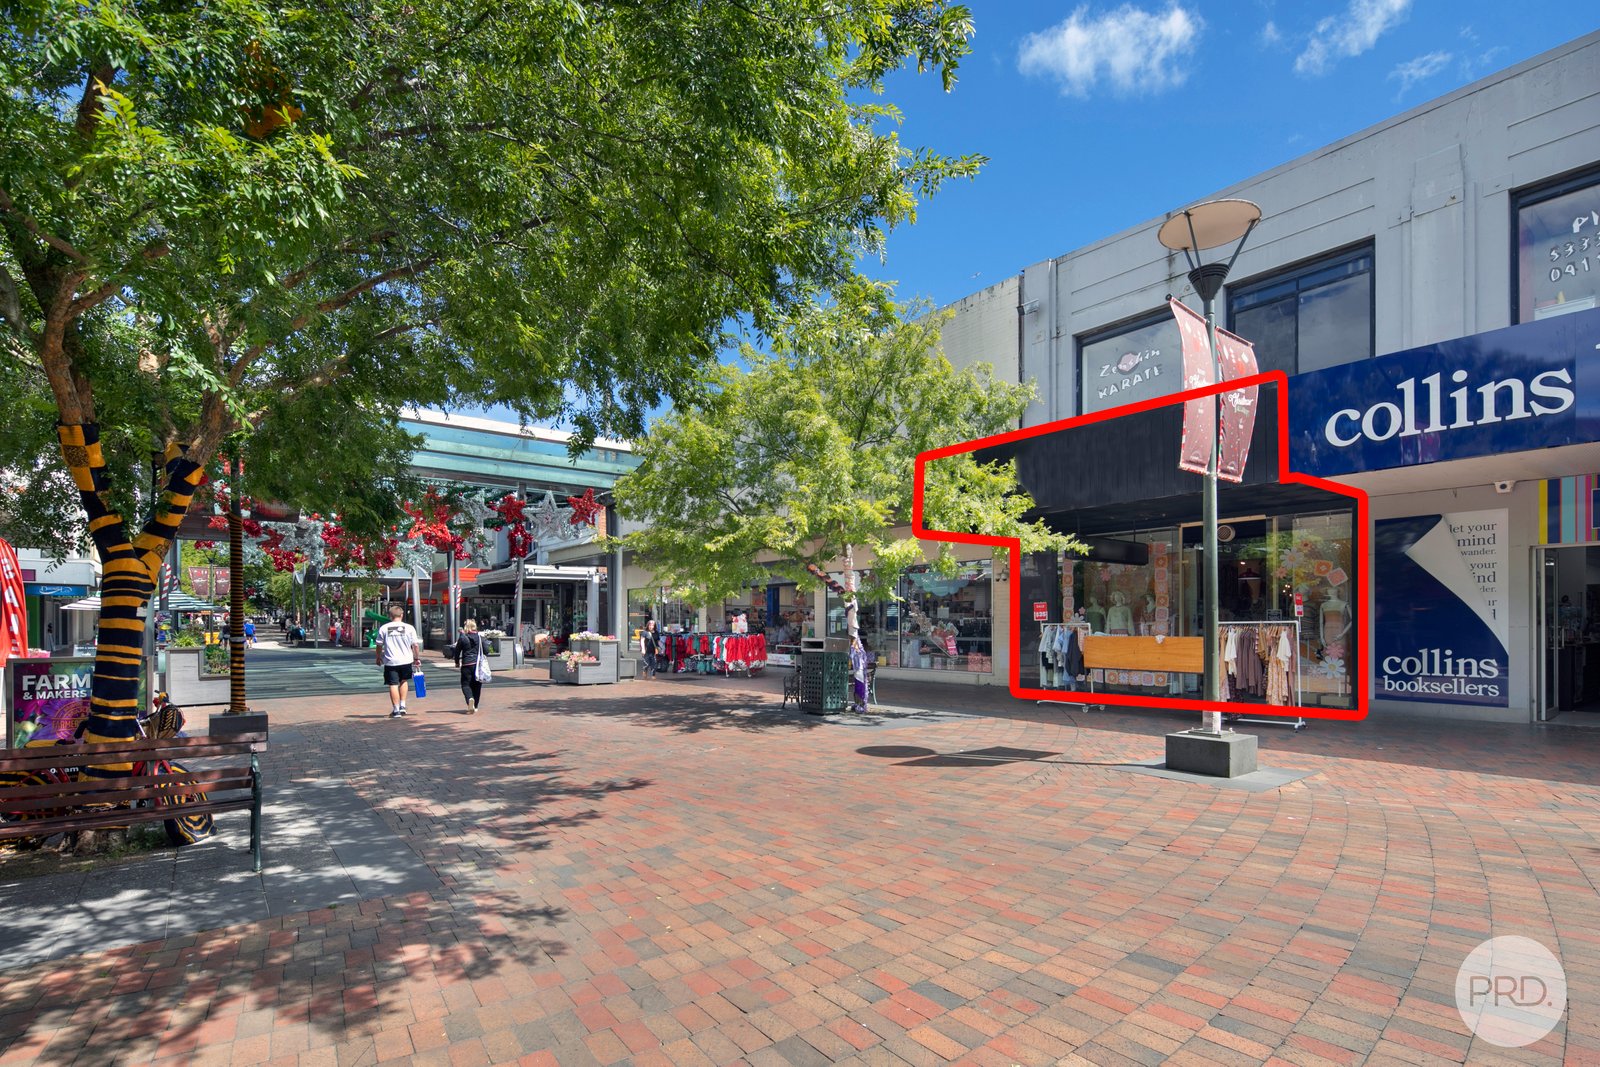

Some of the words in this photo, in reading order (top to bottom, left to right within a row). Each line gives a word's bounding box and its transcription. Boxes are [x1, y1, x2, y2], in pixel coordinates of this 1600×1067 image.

[1098, 366, 1161, 399] KARATE
[1325, 367, 1575, 448] collins
[1467, 523, 1497, 534] your
[1457, 533, 1496, 547] mind
[1460, 548, 1497, 556] wander.
[1469, 562, 1497, 571] your
[1382, 648, 1499, 679] collins
[22, 673, 91, 691] FARM
[1383, 675, 1500, 697] booksellers
[22, 691, 33, 701] &
[36, 689, 87, 700] MAKERS
